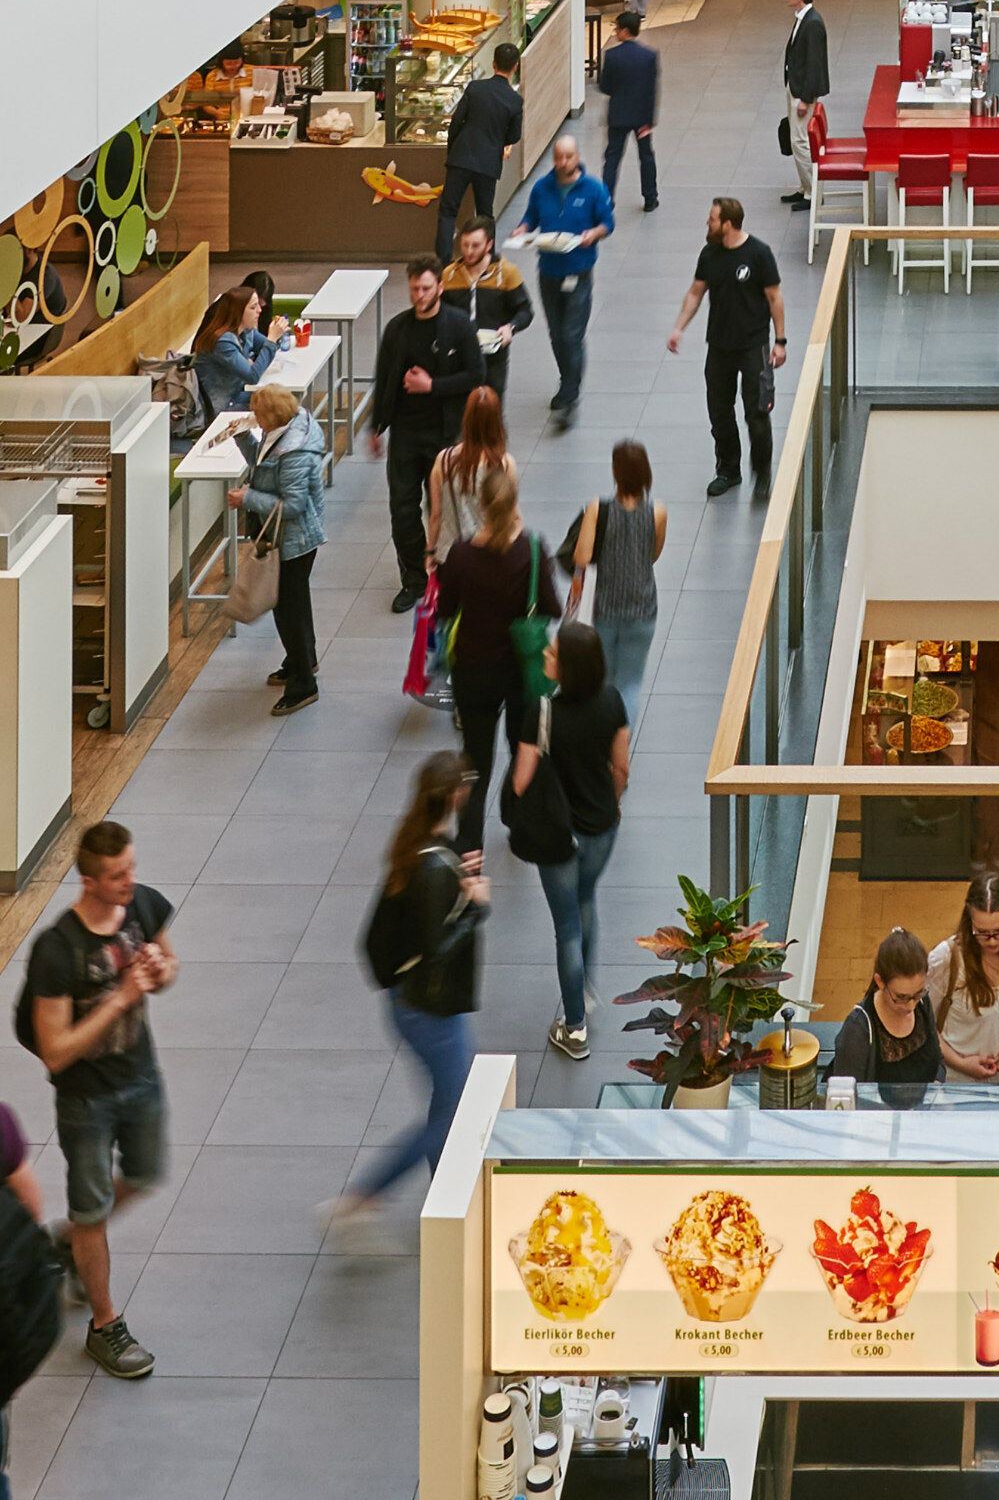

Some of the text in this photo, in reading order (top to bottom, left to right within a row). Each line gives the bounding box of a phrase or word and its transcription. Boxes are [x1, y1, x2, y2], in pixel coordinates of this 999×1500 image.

[524, 1328, 615, 1340] Eierlikör Becher
[675, 1328, 764, 1340] Krokant Becher
[828, 1329, 915, 1340] Erdbeer Becher
